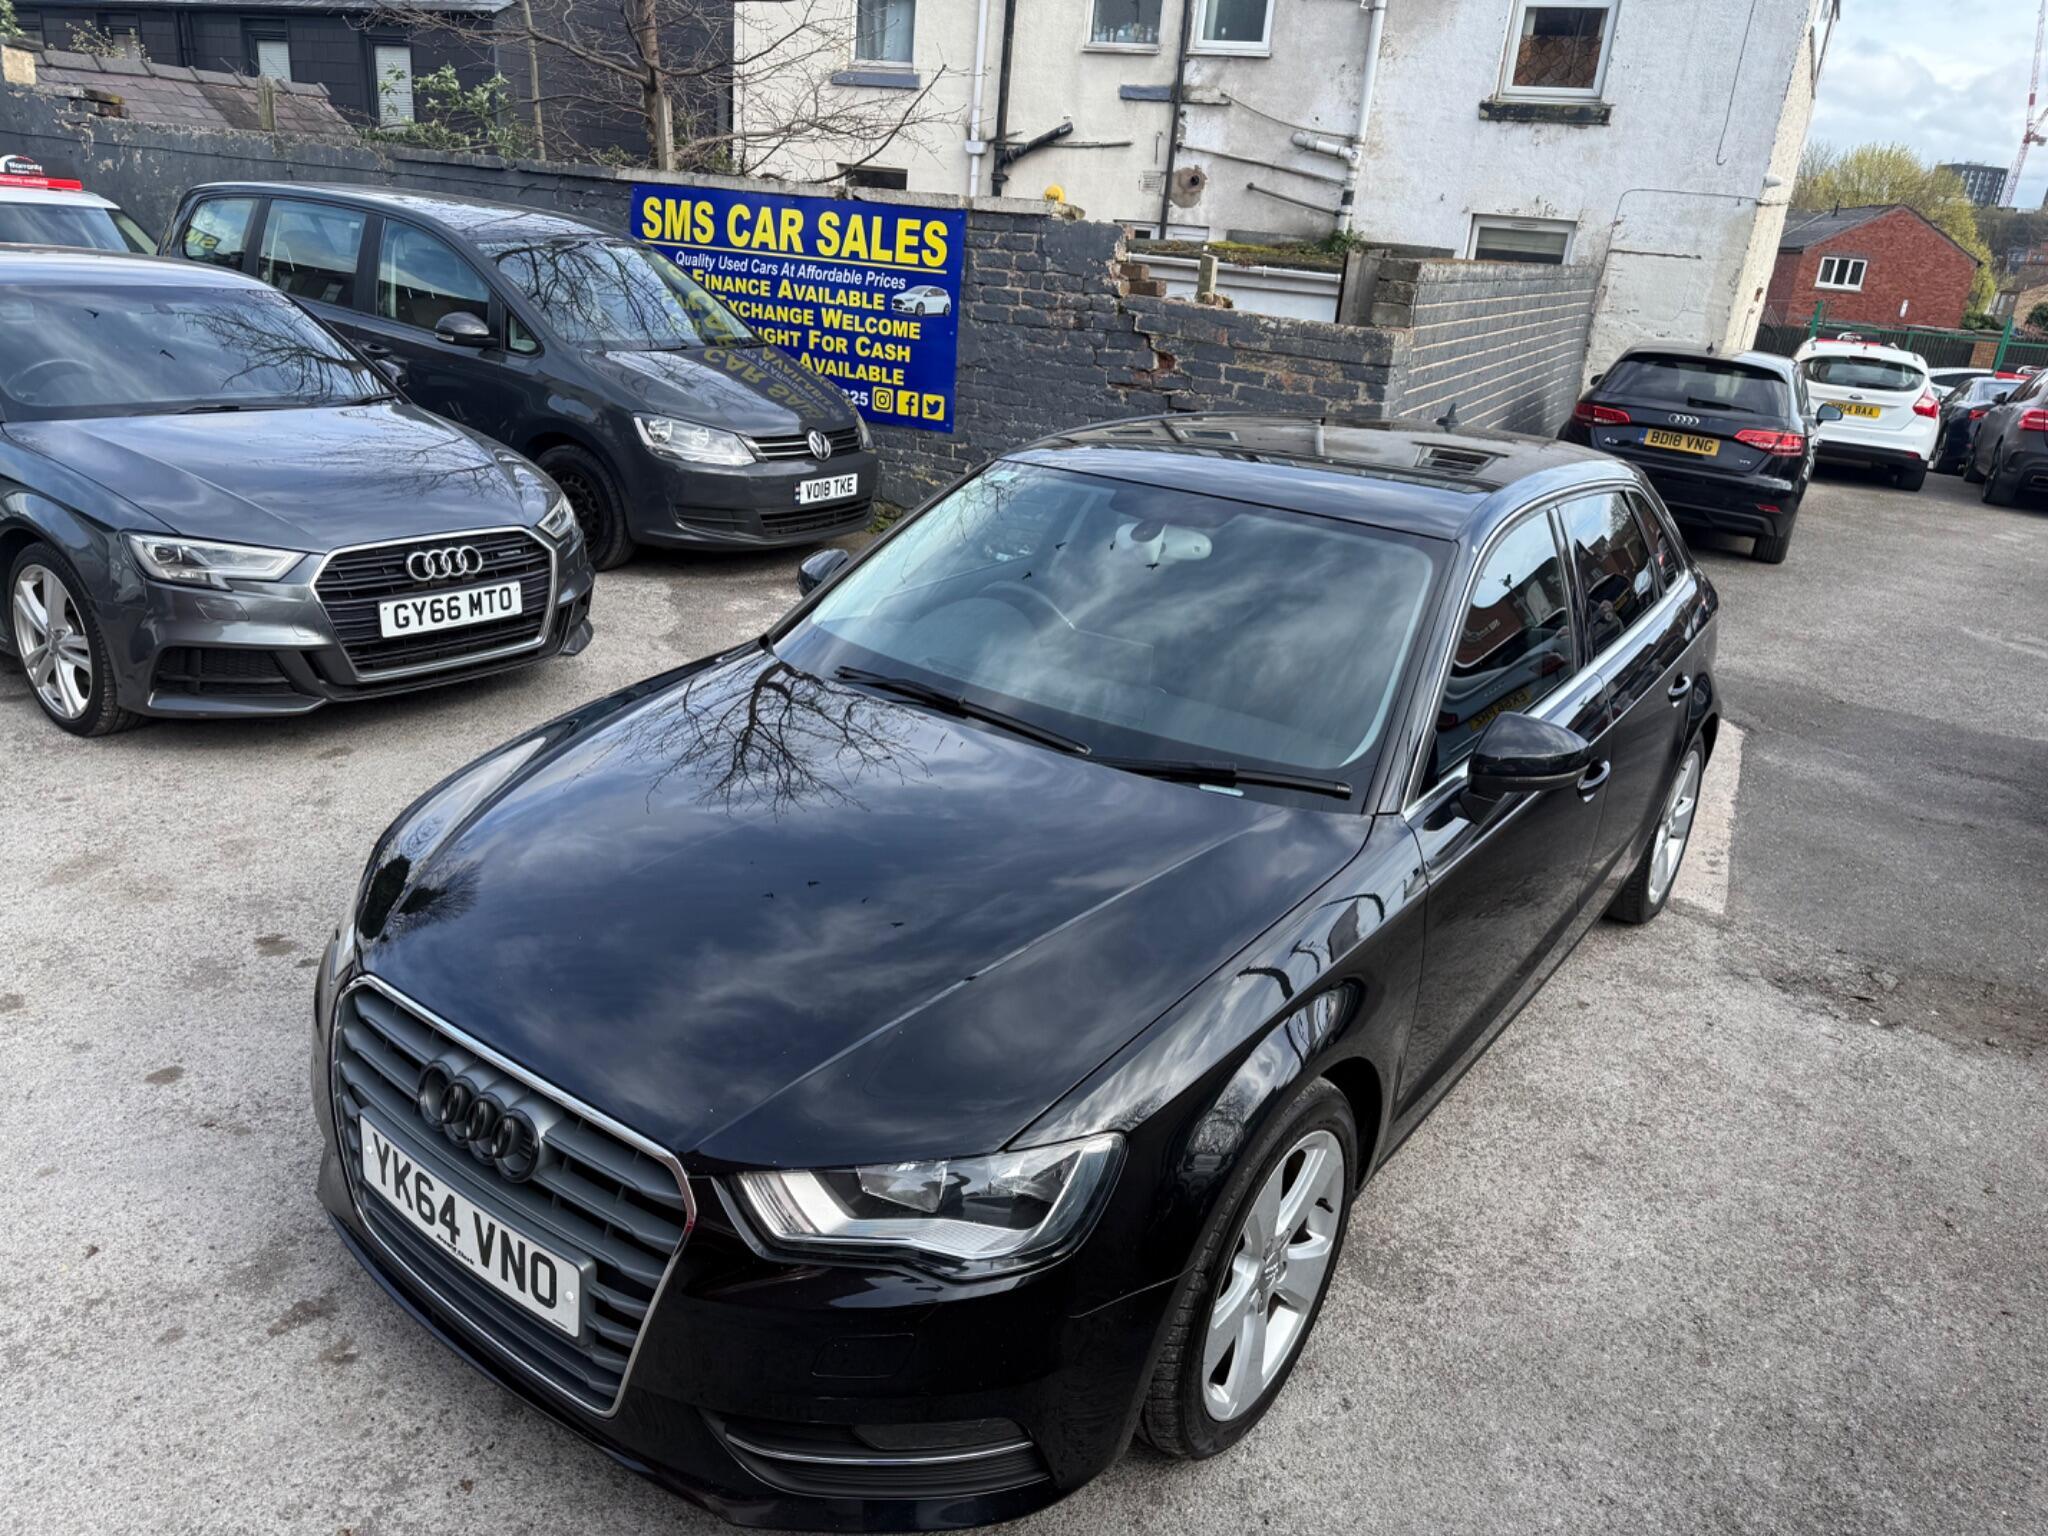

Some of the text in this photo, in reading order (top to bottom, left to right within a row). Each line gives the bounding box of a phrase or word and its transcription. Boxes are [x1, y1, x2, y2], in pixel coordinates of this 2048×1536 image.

[642, 196, 948, 267] SMS CAR SALES
[676, 251, 906, 290] Quality Used Cars At Affordable Prices
[692, 269, 885, 310] FINANCE AVAILABLE
[715, 294, 921, 340] XCHANGE WELCOME
[800, 352, 905, 386] AVAILABLE
[855, 336, 911, 363] CASH
[1651, 431, 1713, 452] BD18 VNG
[806, 477, 853, 500] VO18 TKE
[394, 587, 512, 629] GY66 MTO
[373, 1132, 557, 1309] YK64 VNO
